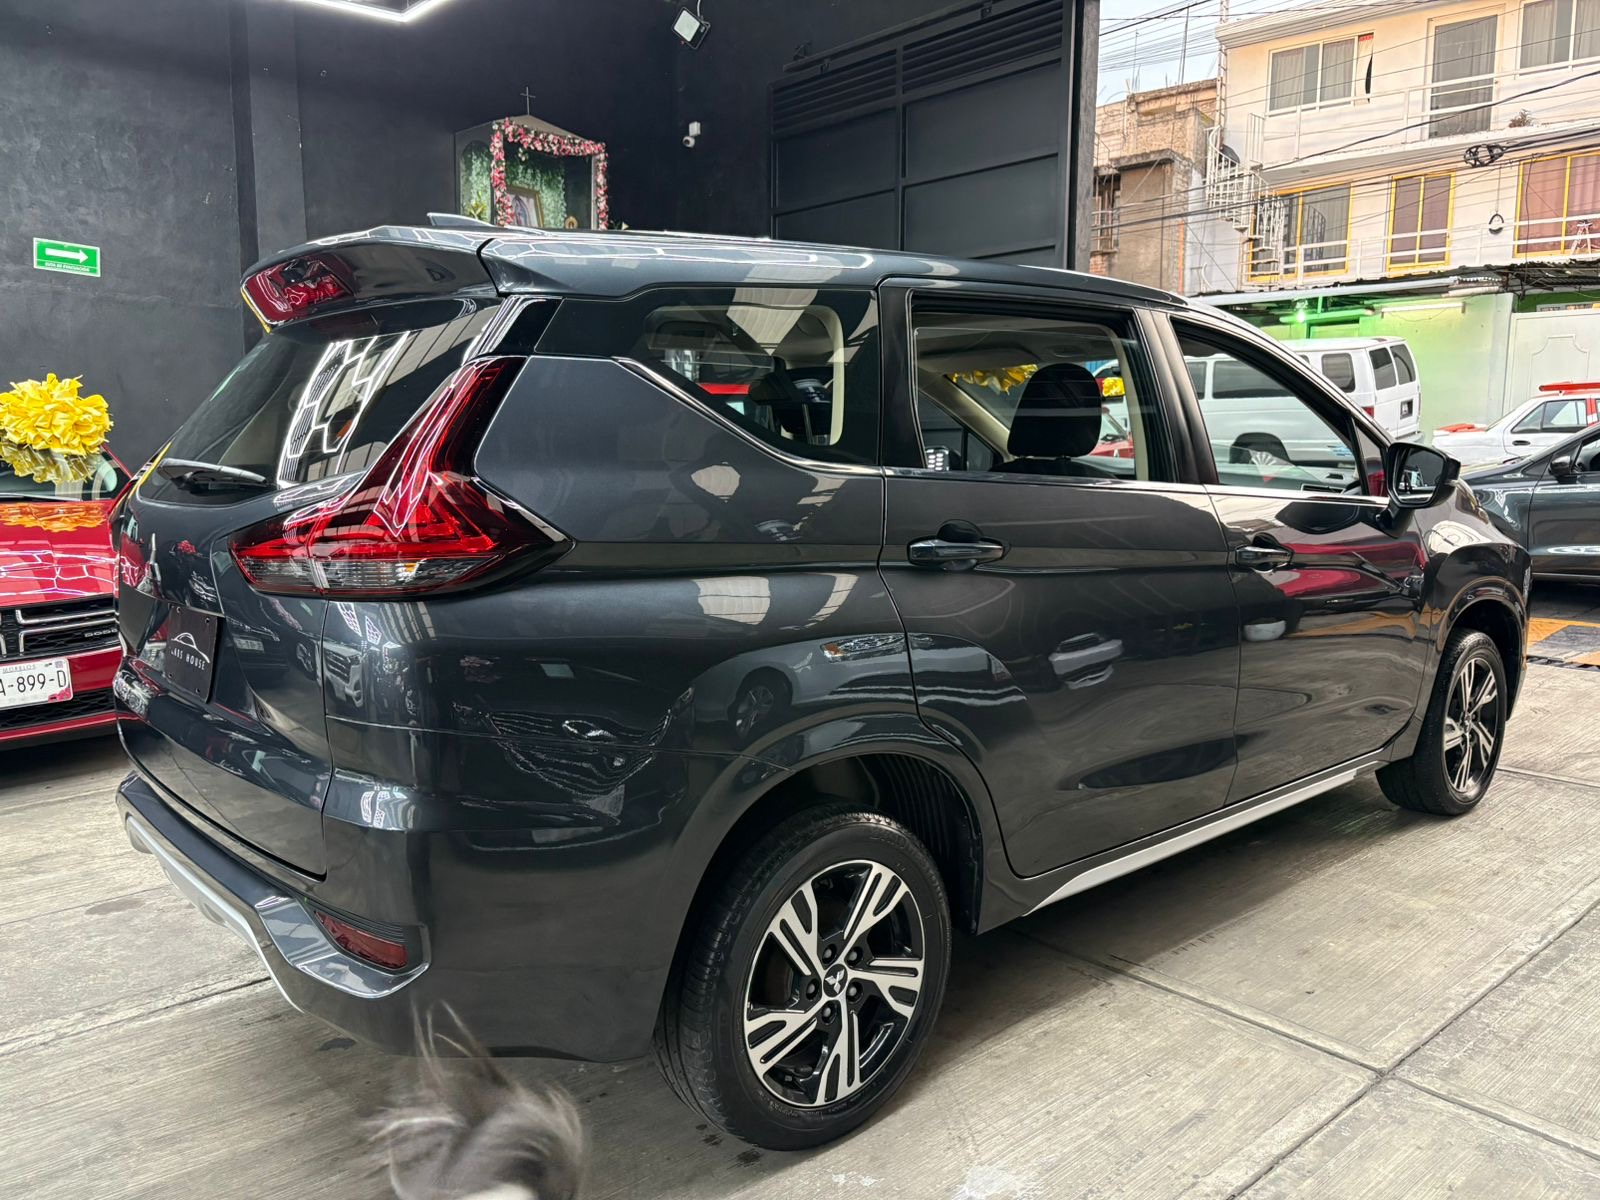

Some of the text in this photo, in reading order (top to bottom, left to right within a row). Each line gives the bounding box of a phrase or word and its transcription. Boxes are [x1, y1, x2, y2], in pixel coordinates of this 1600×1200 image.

[84, 628, 118, 637] DODG
[185, 653, 206, 671] HOUSE
[2, 664, 36, 674] MORELOS
